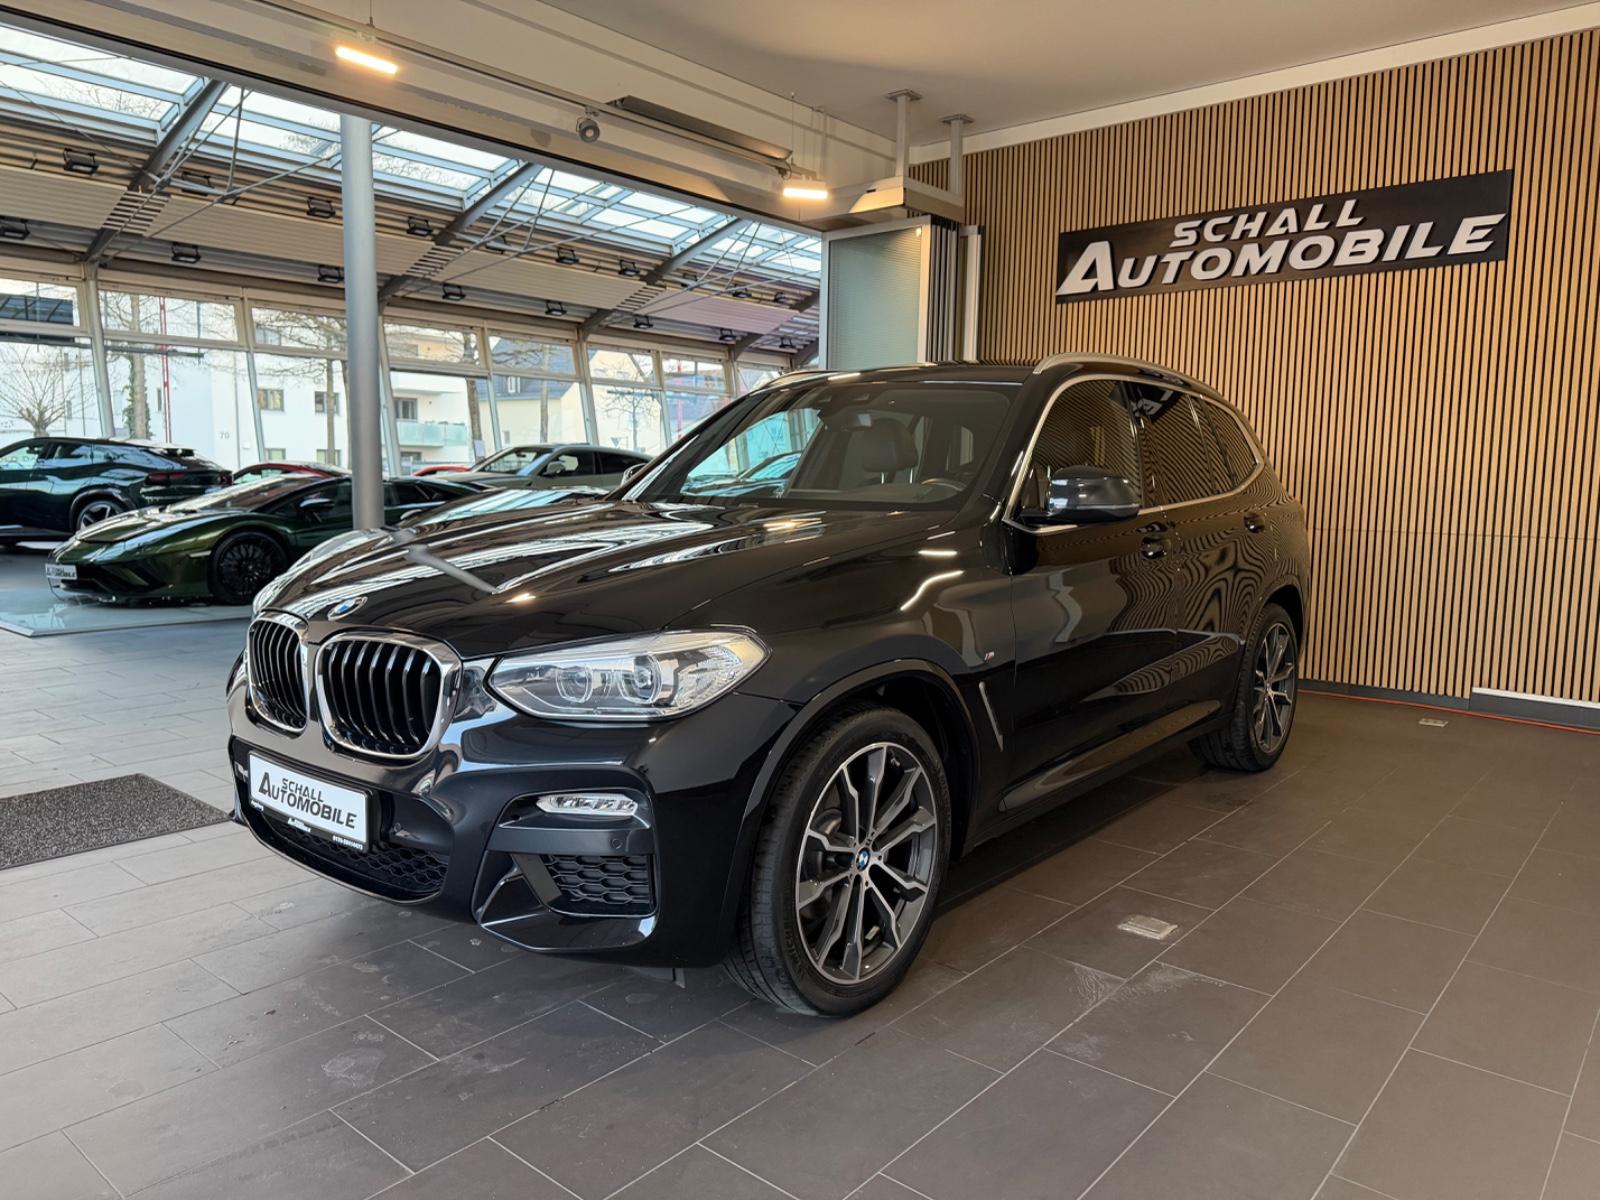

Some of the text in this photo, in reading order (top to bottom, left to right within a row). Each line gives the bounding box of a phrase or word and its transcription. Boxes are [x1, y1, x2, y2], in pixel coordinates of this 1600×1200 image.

[1170, 199, 1366, 247] SCHALL
[1055, 213, 1507, 297] AUTOMOBILE
[258, 772, 357, 829] AUTOMOBILE
[281, 778, 324, 802] SCHALL
